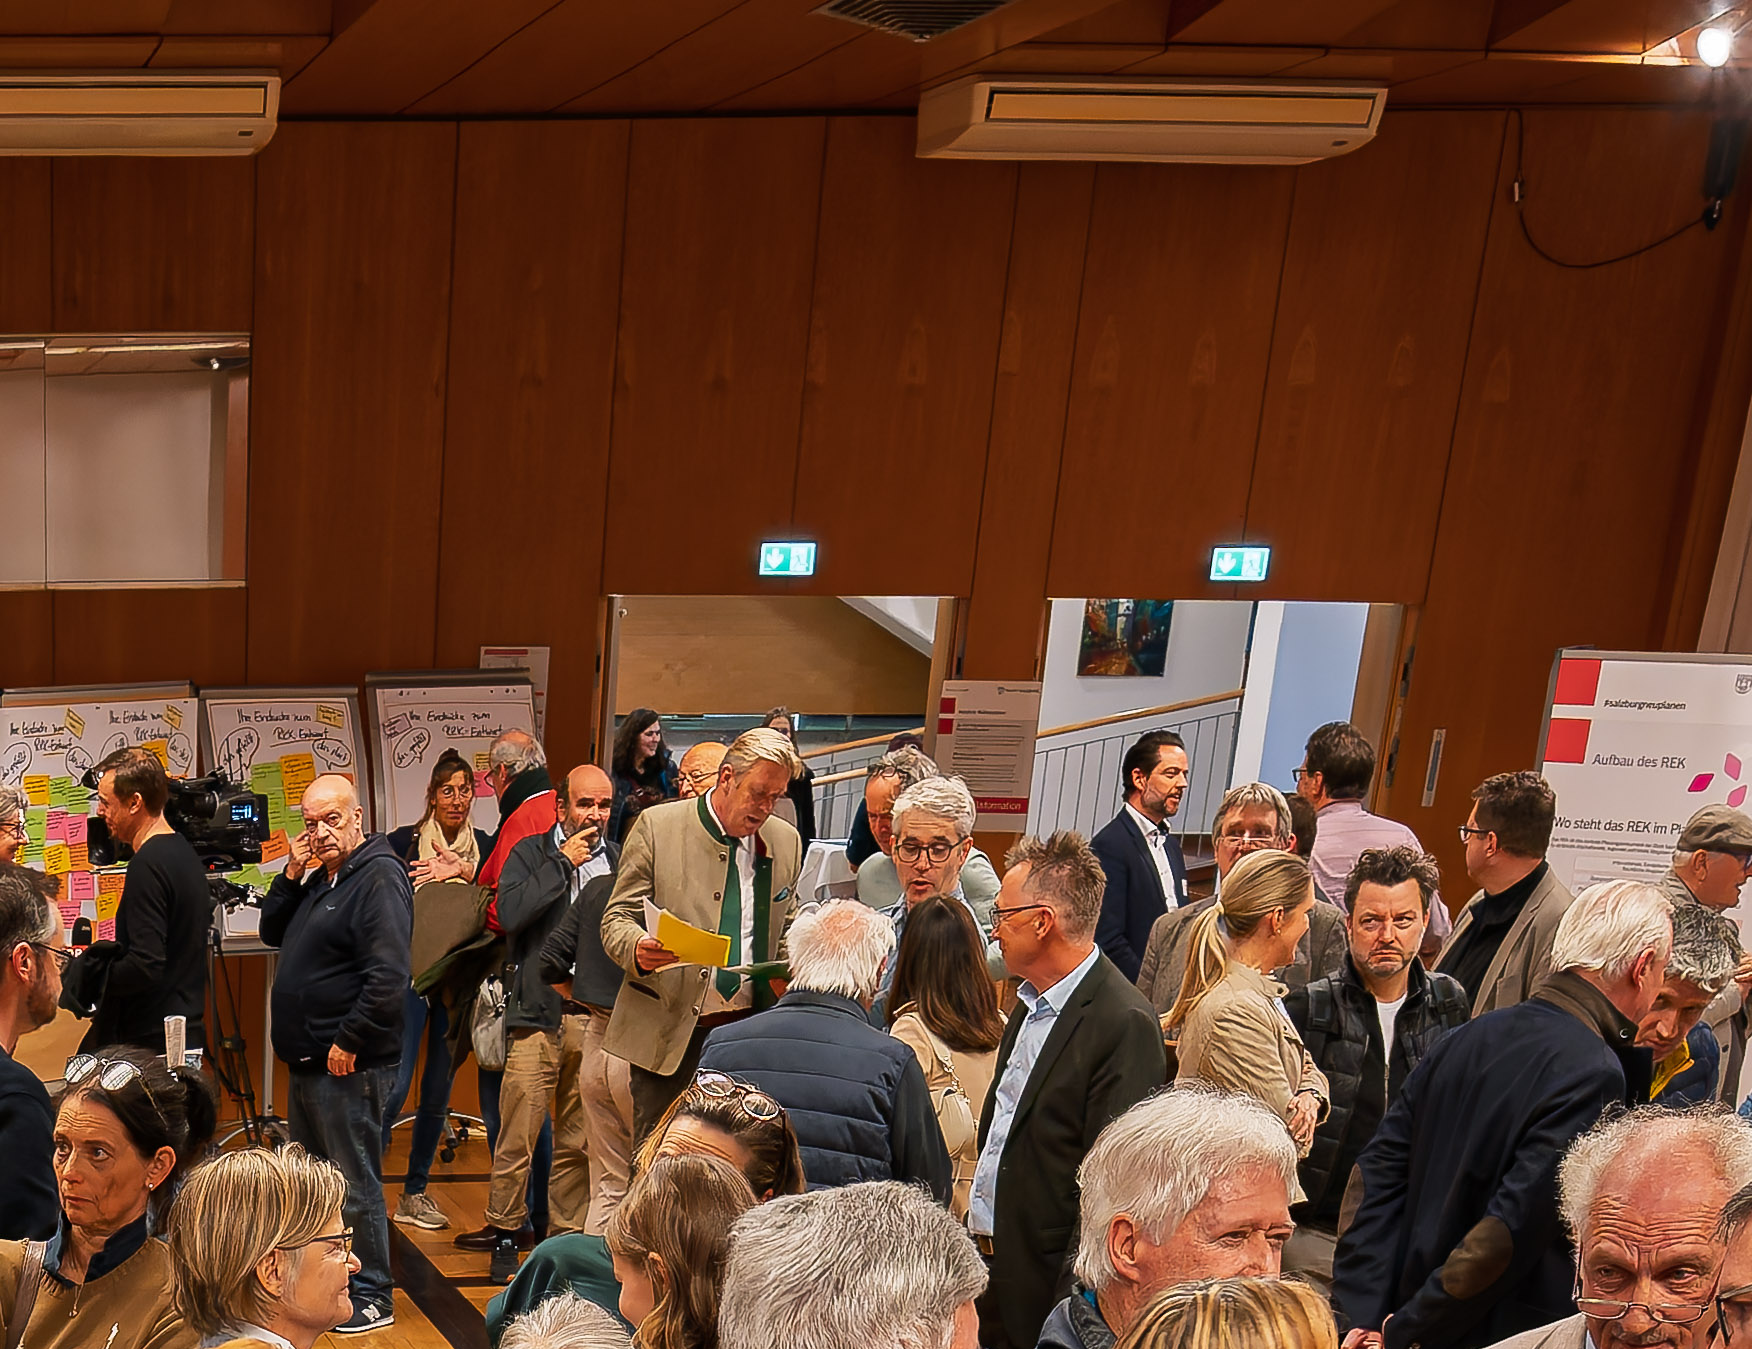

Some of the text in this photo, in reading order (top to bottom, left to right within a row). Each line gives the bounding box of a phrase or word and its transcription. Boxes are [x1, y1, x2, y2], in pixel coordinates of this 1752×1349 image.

[1592, 754, 1686, 769] Aufbau des REK
[1573, 818, 1600, 830] steht
[1604, 820, 1624, 832] das
[1626, 820, 1650, 833] REK
[1654, 822, 1667, 834] im
